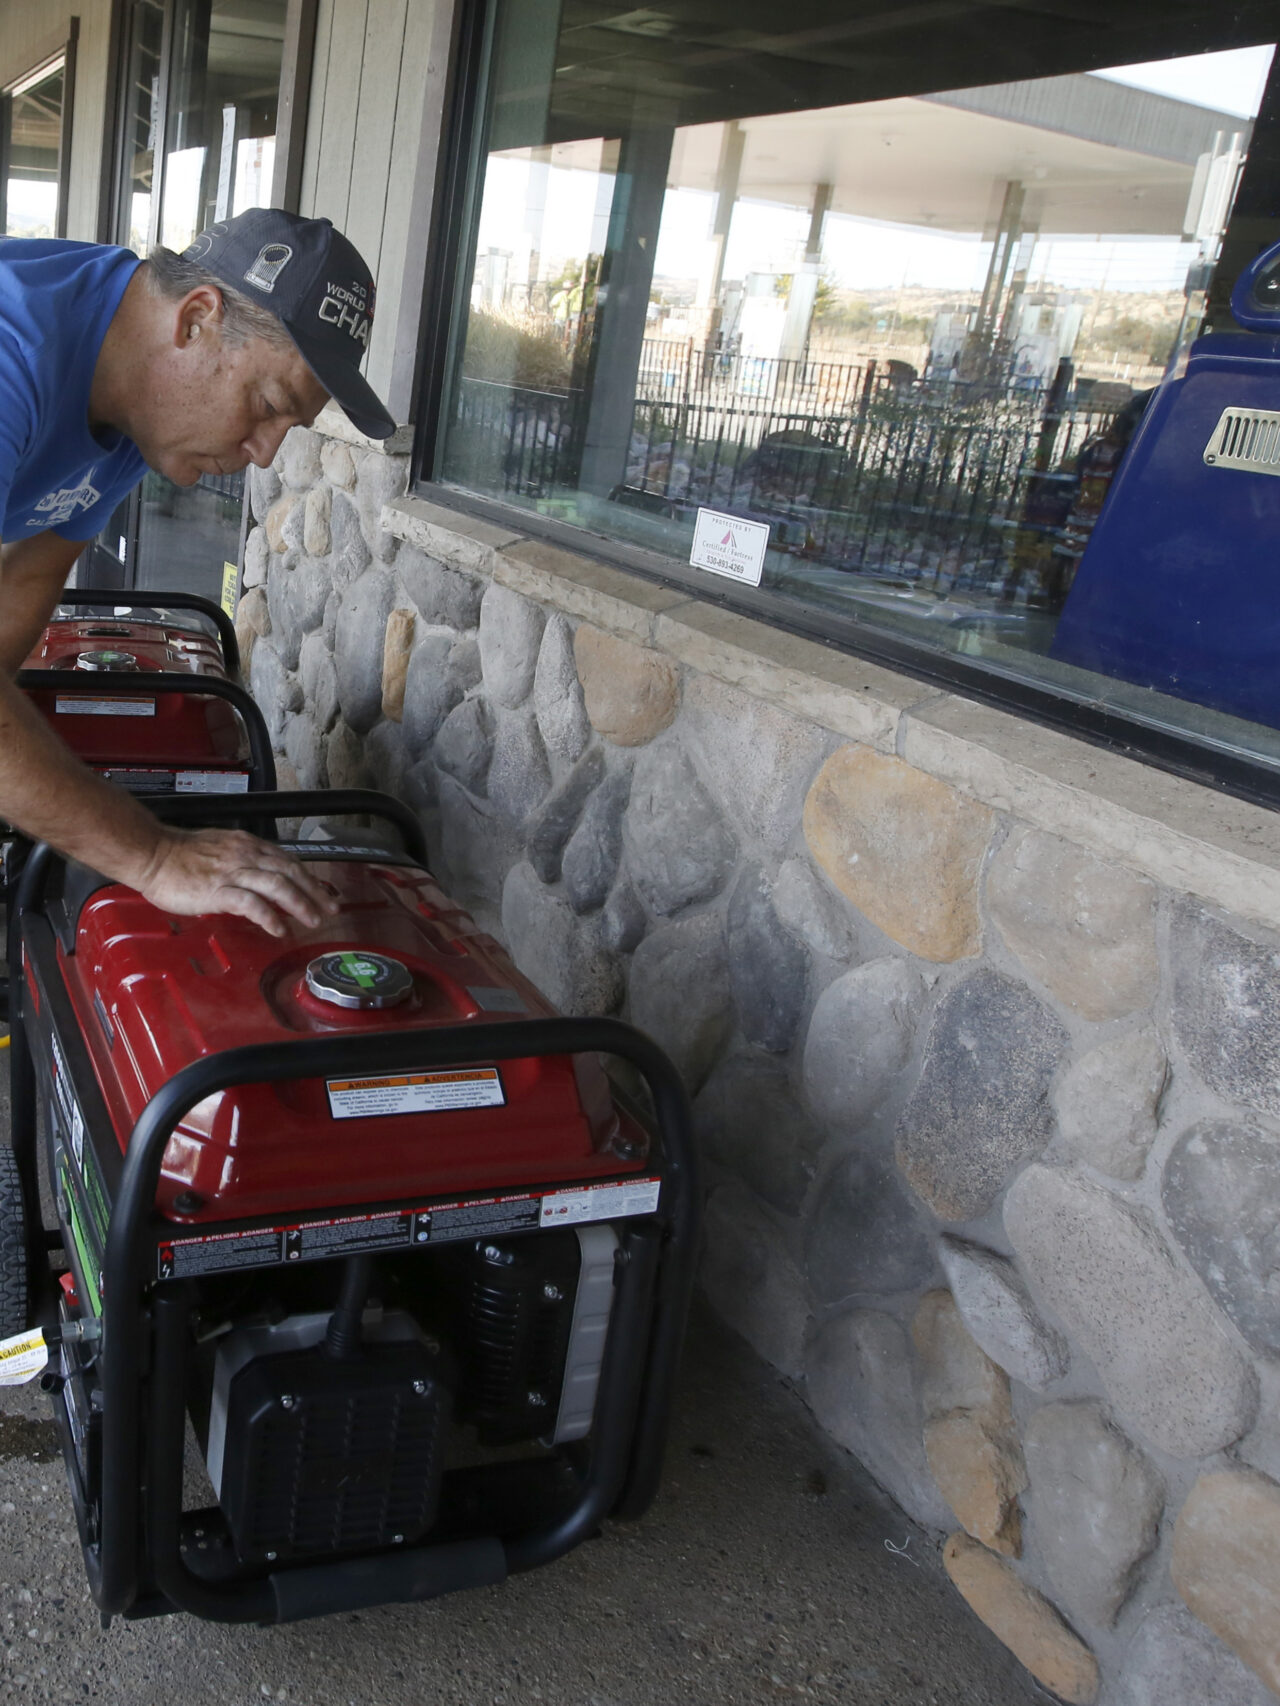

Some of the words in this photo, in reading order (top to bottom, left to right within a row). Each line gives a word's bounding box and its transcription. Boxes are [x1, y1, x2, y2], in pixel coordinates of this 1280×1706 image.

[327, 281, 366, 311] WORLD
[352, 281, 367, 298] 20
[355, 1079, 390, 1089] WARNING
[3, 1341, 32, 1359] CAUTION
